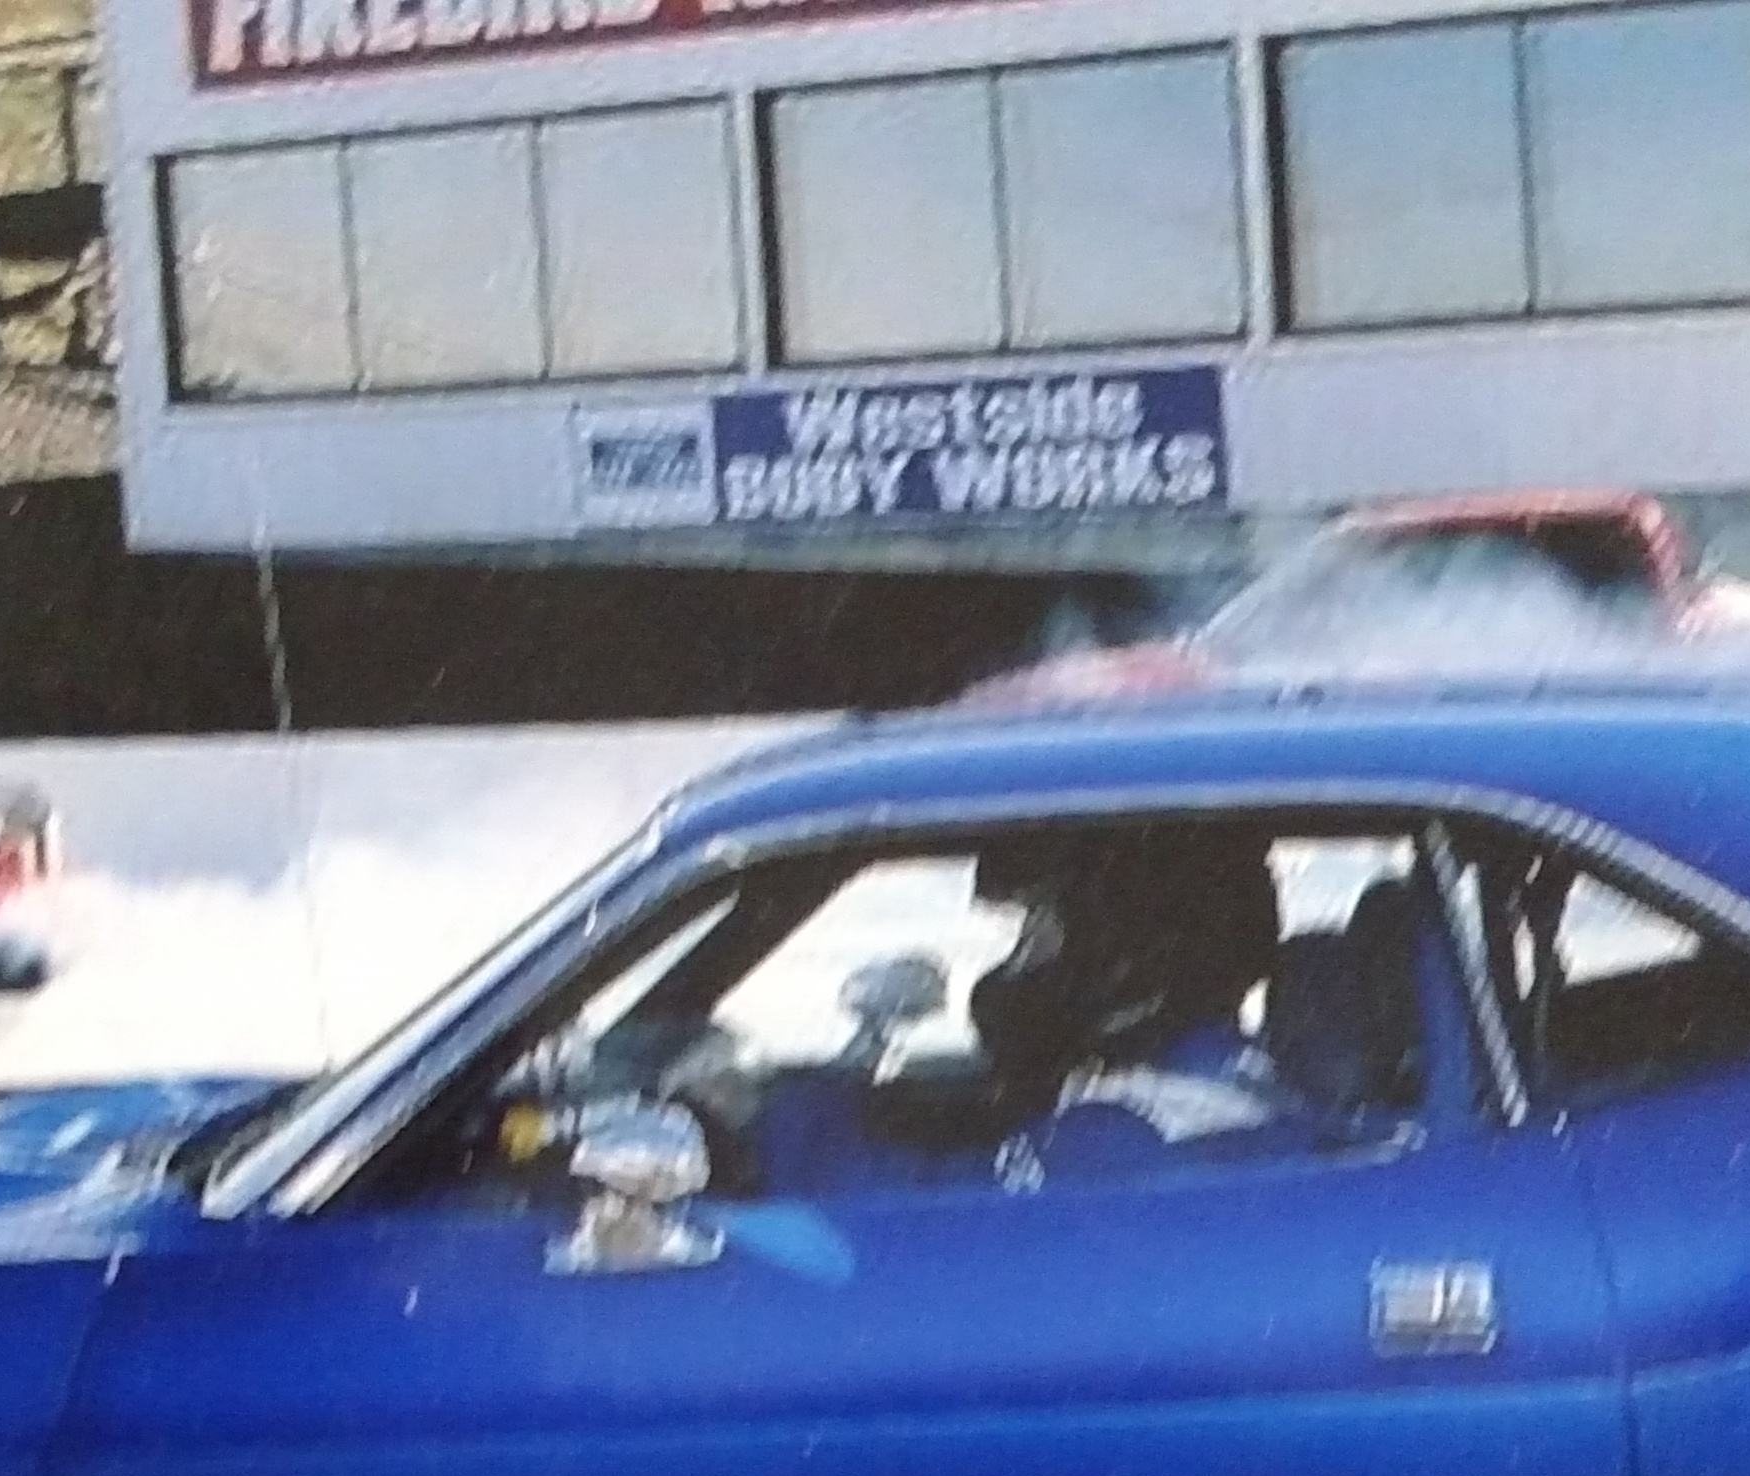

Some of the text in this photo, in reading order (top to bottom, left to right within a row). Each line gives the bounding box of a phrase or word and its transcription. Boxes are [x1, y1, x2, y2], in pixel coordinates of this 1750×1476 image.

[206, 0, 657, 73] FIREB
[786, 378, 1143, 456] Westside
[724, 449, 913, 521] BODY
[931, 431, 1216, 515] WORKS
